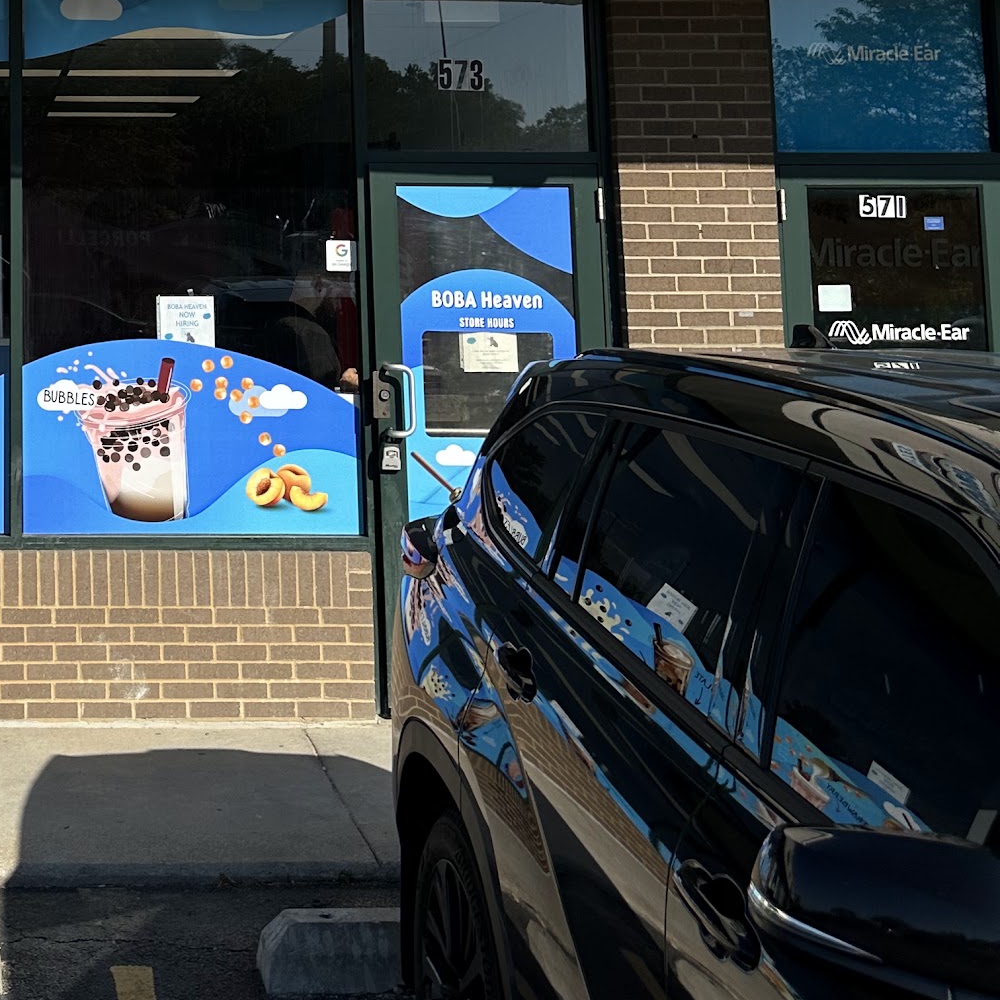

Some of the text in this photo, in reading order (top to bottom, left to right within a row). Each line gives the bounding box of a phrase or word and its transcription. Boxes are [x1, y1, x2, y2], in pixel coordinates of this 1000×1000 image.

[438, 59, 484, 91] 573
[862, 196, 904, 217] 571
[431, 290, 543, 310] BOBA Heaven
[175, 320, 200, 328] HIRING
[459, 317, 515, 329] STORE HOURS
[43, 389, 96, 407] BUBBLES
